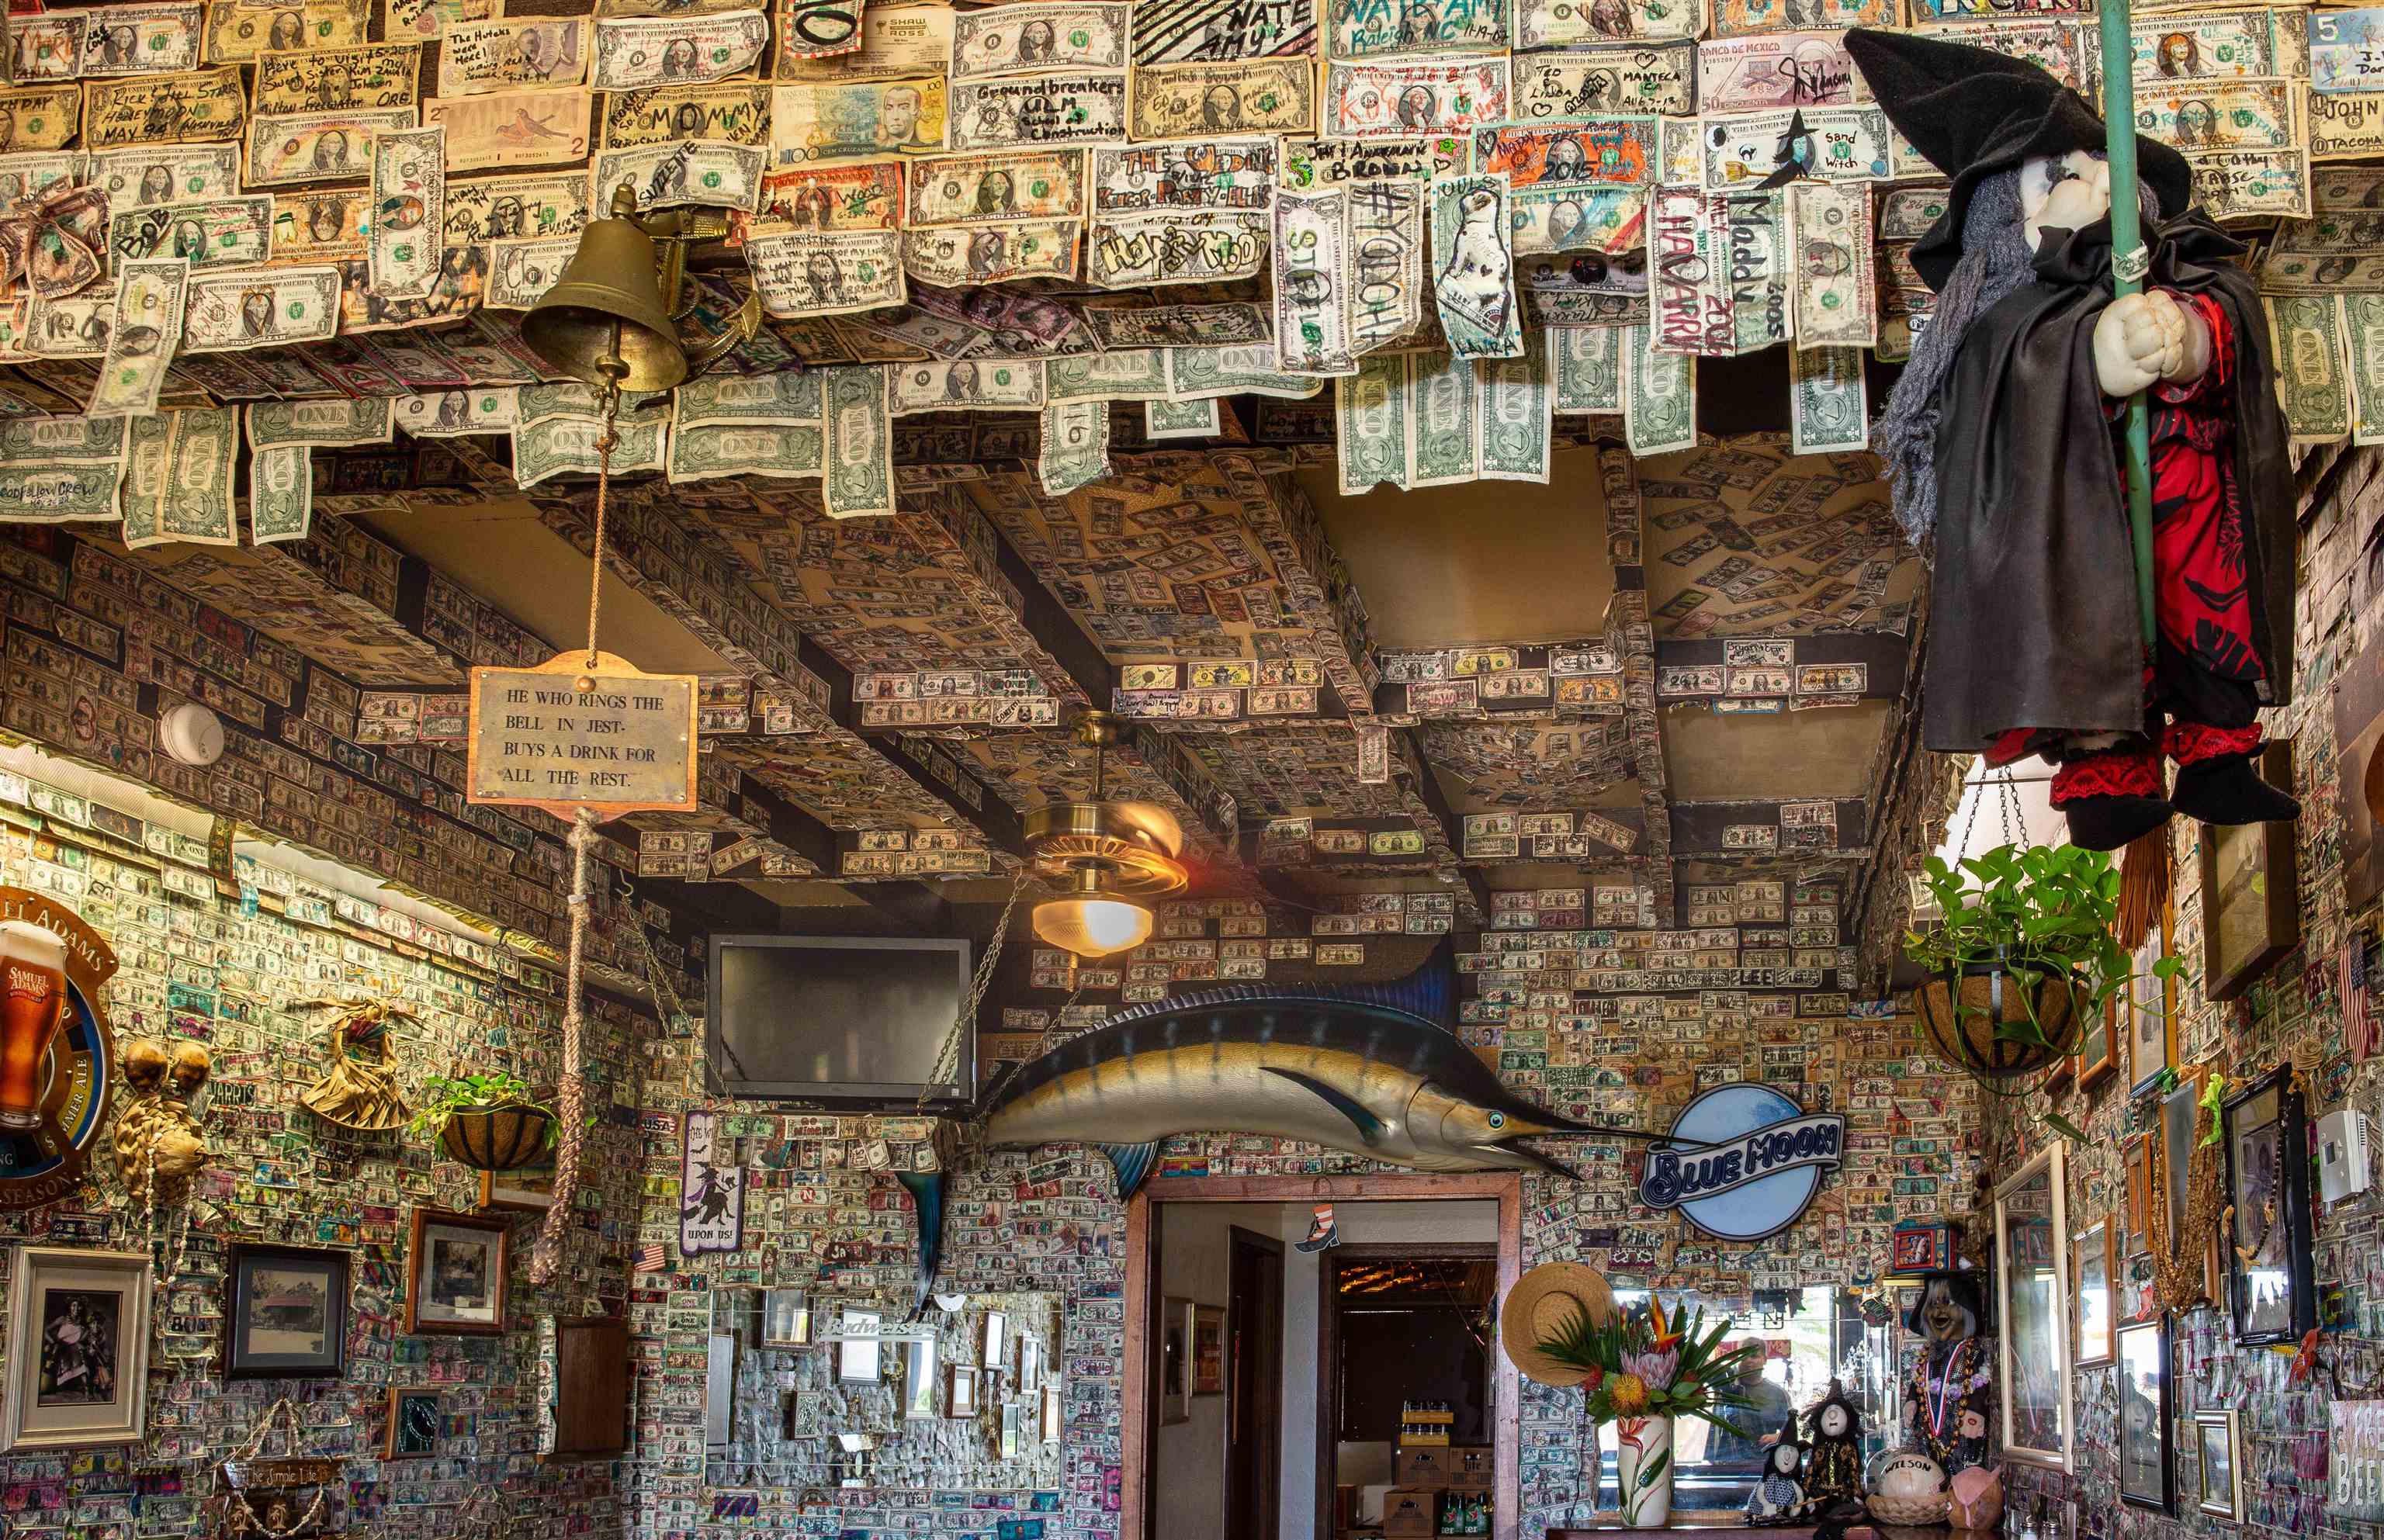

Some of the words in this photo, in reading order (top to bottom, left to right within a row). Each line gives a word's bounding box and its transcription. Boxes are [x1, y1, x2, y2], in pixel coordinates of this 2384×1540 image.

[998, 14, 1024, 23] UNITED
[2200, 19, 2240, 27] AMERICA
[2318, 17, 2338, 40] 5
[1700, 47, 1728, 56] BANCO
[1746, 42, 1780, 52] MEXICO
[1027, 59, 1070, 67] DOLLAR
[1623, 71, 1681, 82] MANTECA
[2325, 99, 2379, 119] JOHN
[572, 137, 584, 154] 2
[1825, 156, 1858, 169] Witch
[985, 212, 1028, 220] DOLLAR
[1095, 353, 1147, 374] ONE
[1221, 349, 1275, 369] ONE
[719, 385, 773, 401] ONE
[295, 407, 348, 424] ONE
[36, 424, 82, 441] ONE
[187, 440, 212, 490] ONE
[507, 690, 528, 703] HE
[535, 691, 573, 704] WHO
[579, 695, 626, 709] RINGS
[633, 697, 664, 711] THE
[506, 717, 543, 730] BELL
[558, 718, 574, 731] IN
[504, 742, 546, 756] BUYS
[551, 745, 563, 757] A
[570, 745, 620, 760] DRINK
[625, 749, 656, 762] FOR
[503, 769, 535, 783] ALL
[547, 771, 579, 784] THE
[590, 773, 631, 787] REST.
[189, 846, 206, 858] ONE
[35, 906, 104, 971] ADAMS
[9, 967, 49, 988] SAMUEL
[1740, 969, 1772, 985] LEE
[10, 978, 46, 997] ADAMS
[75, 1058, 88, 1088] ALE
[643, 1118, 672, 1133] USA
[688, 1126, 702, 1141] THE
[1643, 1150, 1743, 1204] BLUE
[1745, 1124, 1839, 1174] MOON
[688, 1229, 713, 1240] UPON
[718, 1229, 733, 1240] US!
[1886, 1459, 1932, 1474] WILSON
